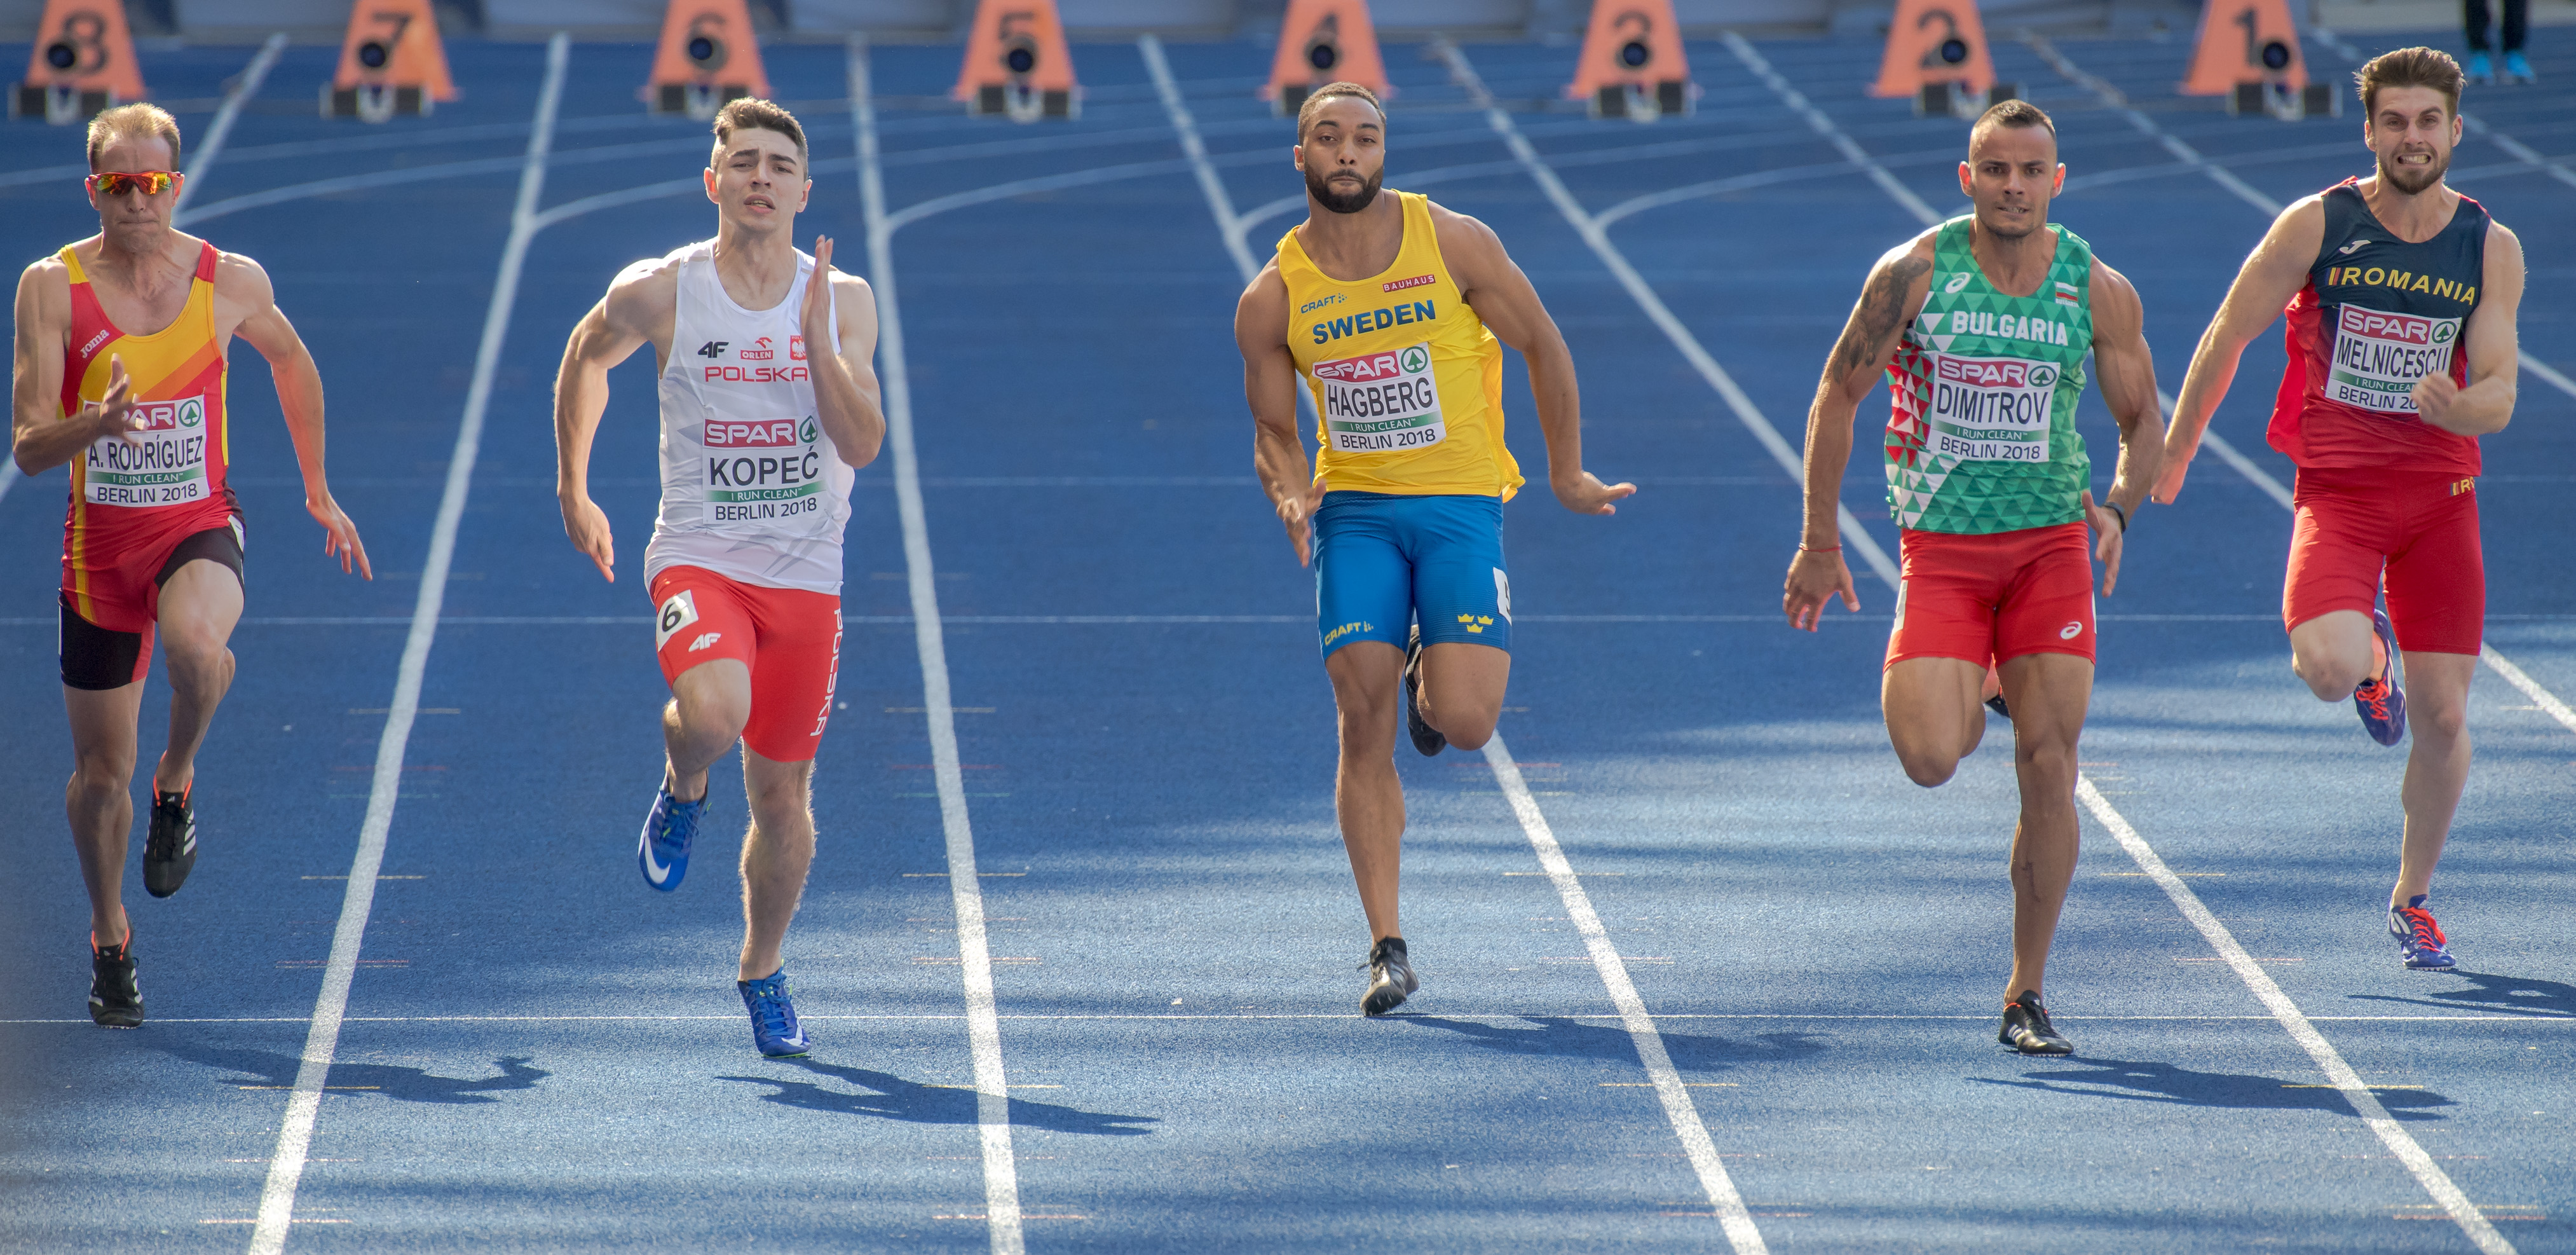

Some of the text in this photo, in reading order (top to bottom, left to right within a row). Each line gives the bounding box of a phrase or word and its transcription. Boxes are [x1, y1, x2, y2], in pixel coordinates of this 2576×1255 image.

[64, 11, 108, 75] 8
[1384, 275, 1435, 292] BAUHAUS
[2341, 267, 2476, 306] ROMANIA
[1300, 295, 1336, 313] CRAFT
[1312, 299, 1436, 345] SWEDEN
[1952, 310, 2068, 346] BULGARIA
[2345, 310, 2428, 341] SPAR
[742, 350, 772, 359] ORLEN
[2336, 335, 2450, 378] MELNICESCU
[705, 366, 808, 382] POLSKA
[1317, 355, 1397, 379] SPAR
[1941, 360, 2024, 384] SPAR
[2362, 379, 2384, 390] RUN
[1328, 377, 1433, 418] HAGBERG
[1937, 383, 2048, 425] DIMITROV
[2339, 385, 2419, 410] BERLIN 20
[706, 423, 794, 444] SPAR
[1340, 429, 1436, 449] BERLIN 2018
[1356, 422, 1375, 432] RUN
[1962, 429, 1986, 439] RUN
[88, 435, 203, 471] A. RODRÍGUEZ
[1940, 437, 2040, 459] BERLIN 2018
[710, 445, 819, 486] KOPEĆ
[118, 474, 140, 484] RUN
[97, 483, 198, 503] BERLIN 2018
[737, 491, 760, 501] RUN
[716, 497, 817, 520] BERLIN 2018
[662, 603, 681, 632] 6
[1325, 622, 1361, 646] CRAFT
[810, 608, 843, 737] POLSKA
